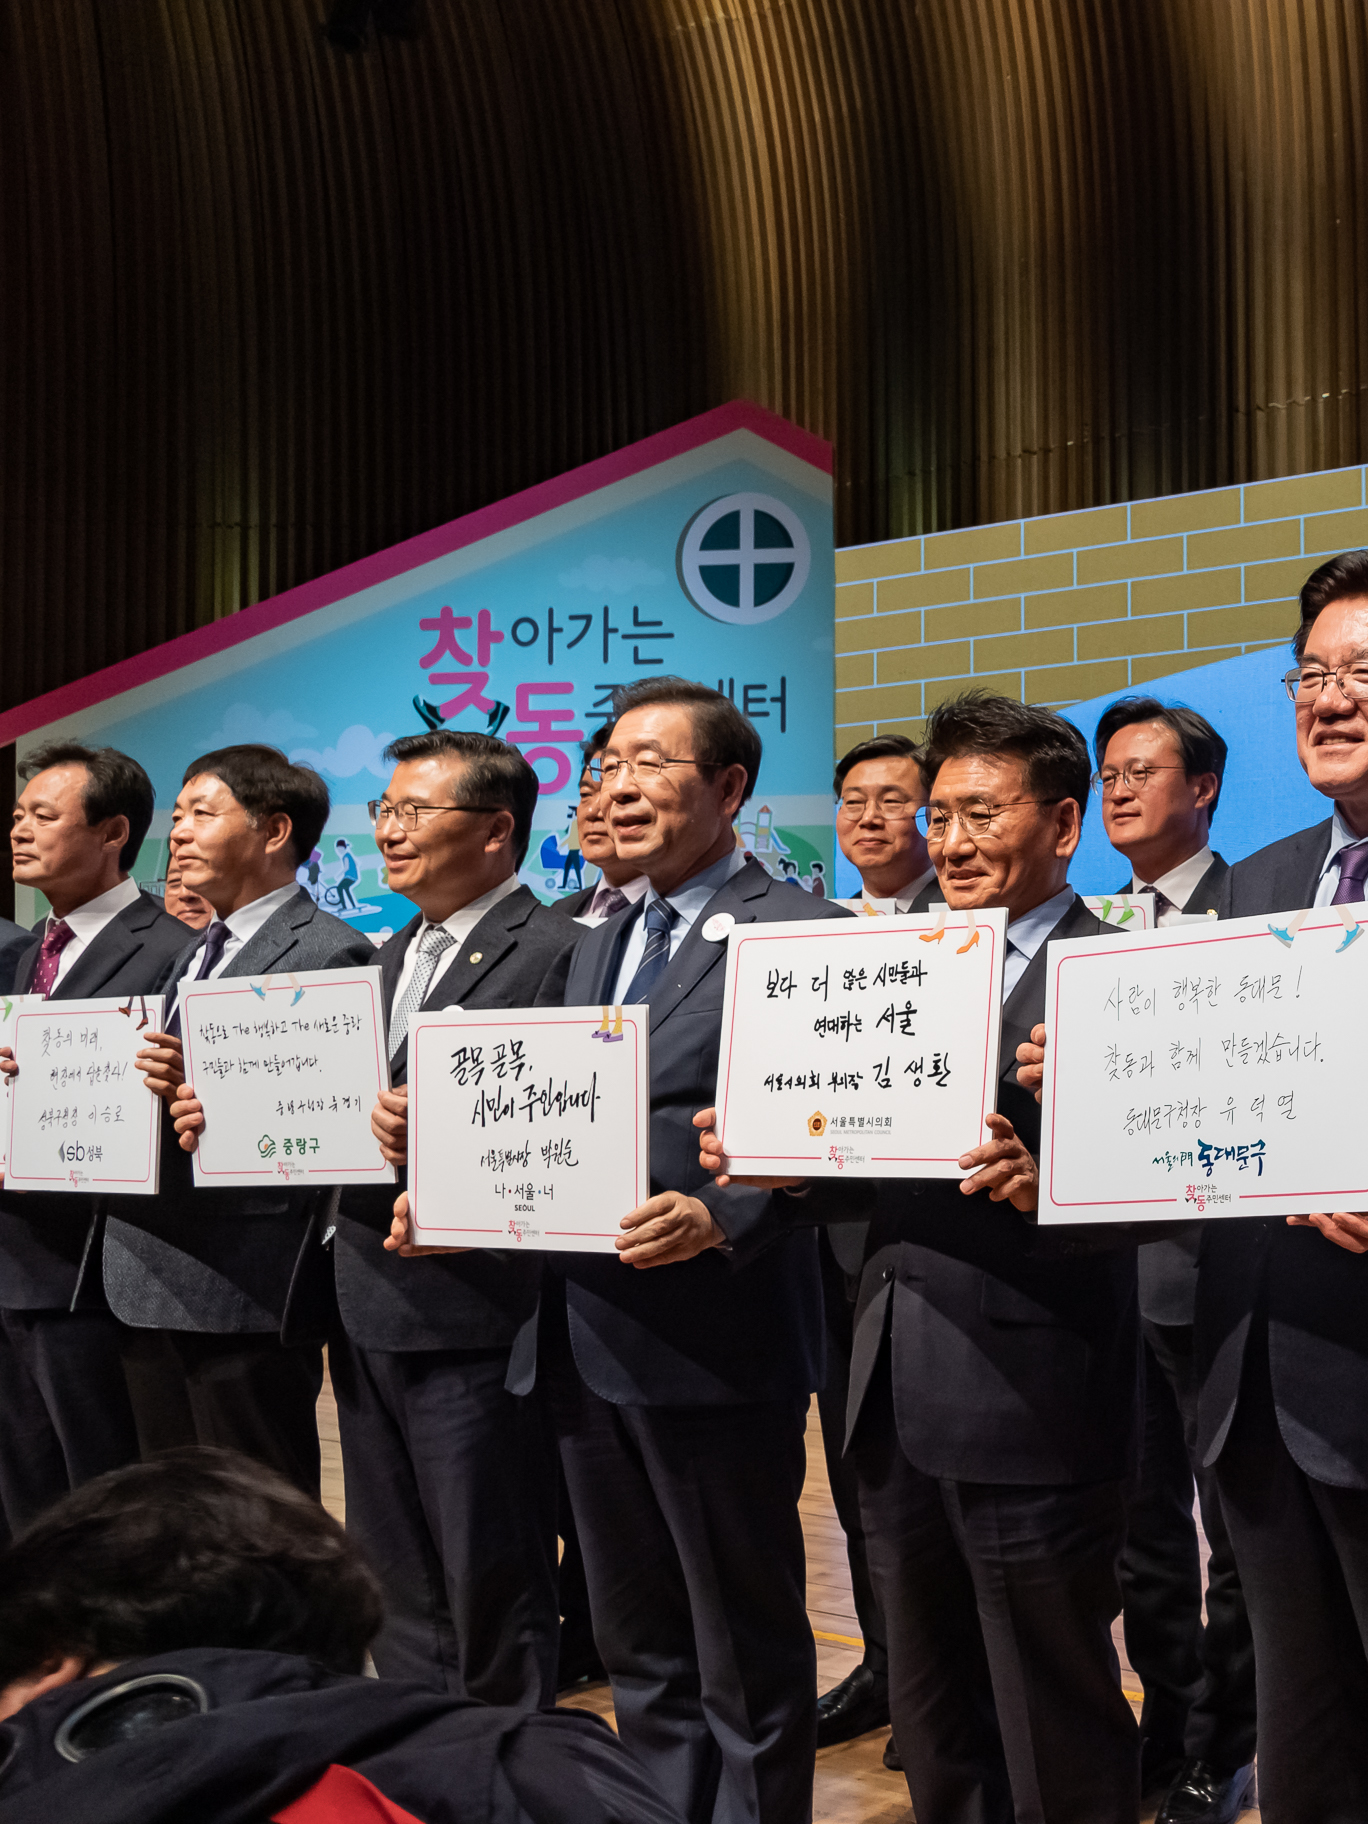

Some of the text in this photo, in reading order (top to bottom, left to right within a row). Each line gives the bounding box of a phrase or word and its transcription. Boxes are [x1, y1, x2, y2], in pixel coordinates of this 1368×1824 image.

[419, 605, 674, 721] 찾아가는
[766, 968, 798, 1000] 보다
[811, 964, 829, 1002] 더
[1104, 977, 1156, 1022] 사람이
[1172, 976, 1222, 1014] 행복한
[813, 999, 918, 1043] 연대하는 서울
[449, 1046, 486, 1087] 골목
[1104, 1031, 1324, 1082] 찾동과 함께 만들겠습니다.
[471, 1083, 515, 1128] 시민이
[830, 1116, 893, 1128] 서울특별시의회
[1123, 1097, 1208, 1136] 동대문구청장
[282, 1137, 321, 1156] 중랑구
[1197, 1138, 1267, 1178] 동대문구
[514, 1204, 536, 1212] SEOUL
[1185, 1184, 1218, 1202] 찾아가는
[1196, 1193, 1232, 1212] 동주민센터
